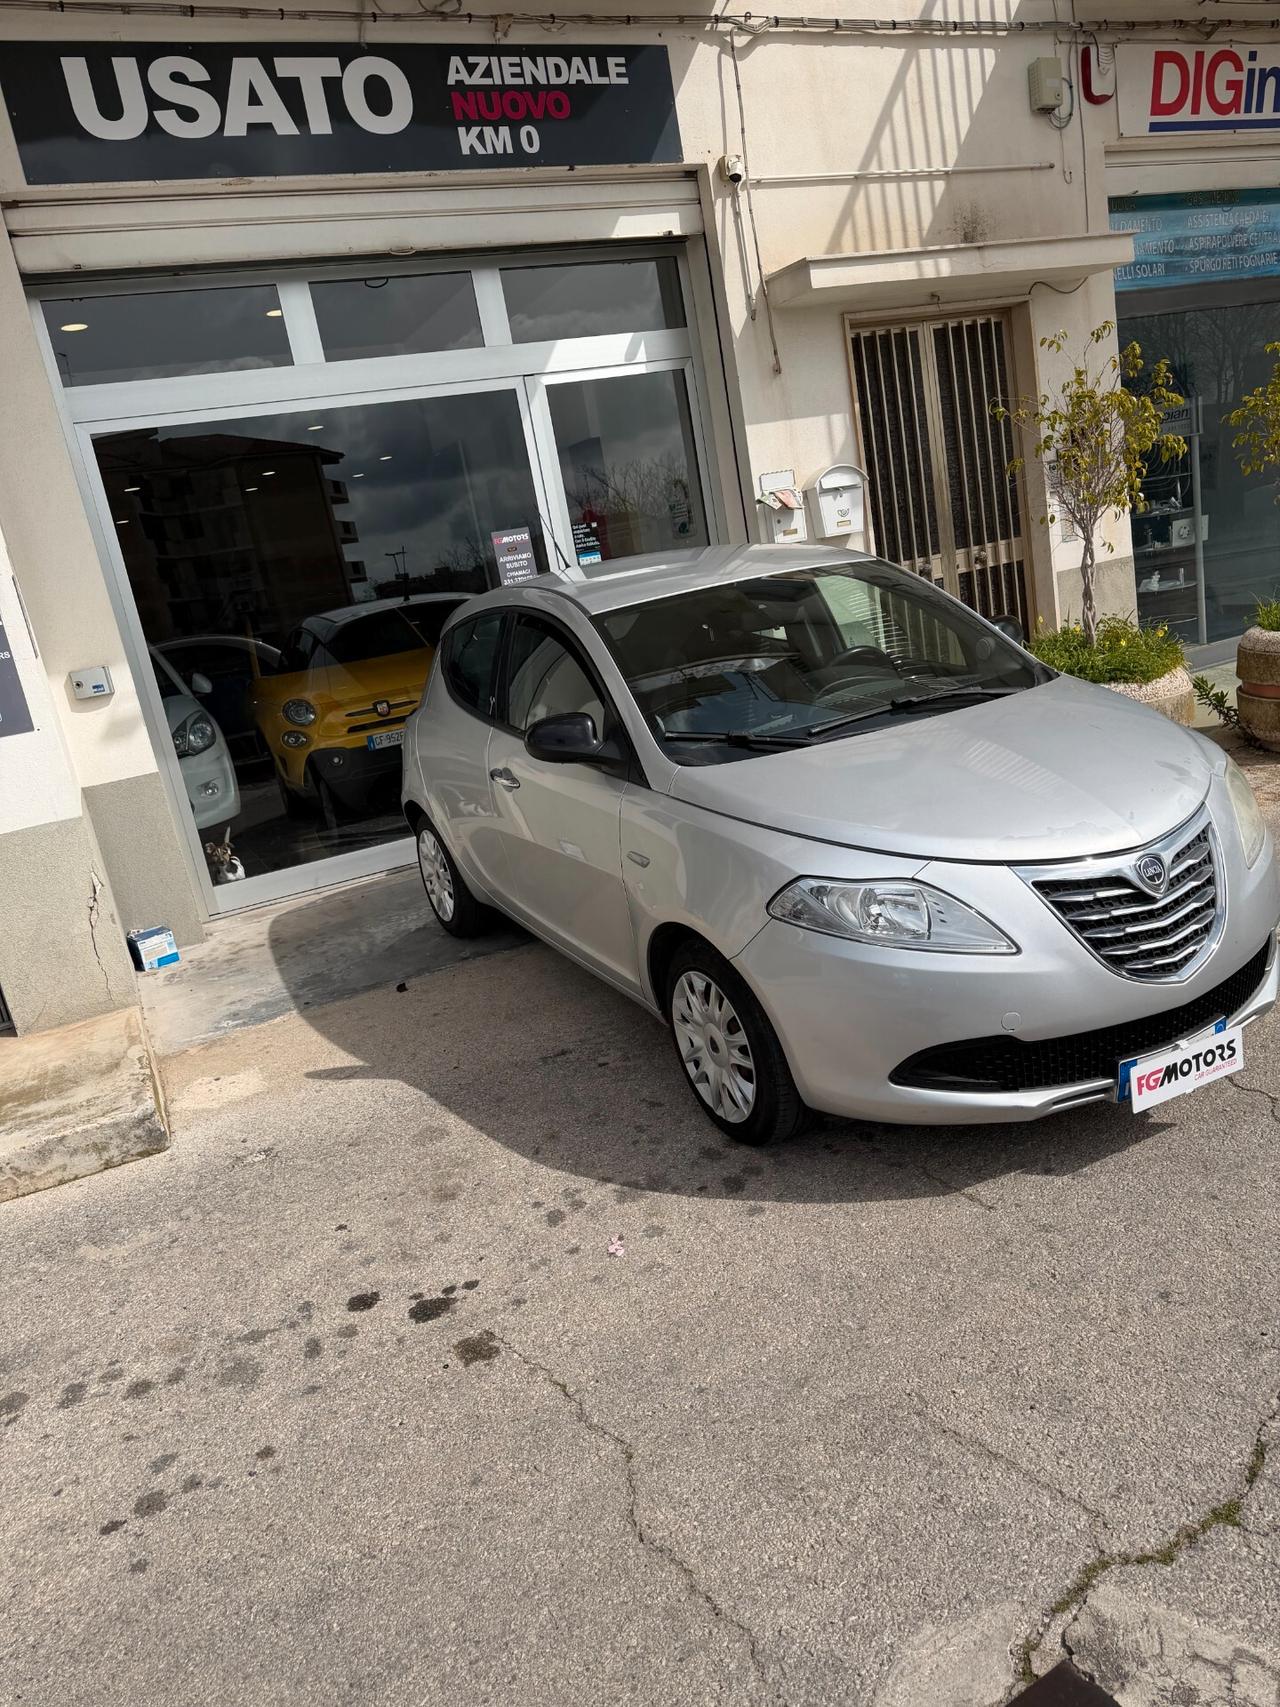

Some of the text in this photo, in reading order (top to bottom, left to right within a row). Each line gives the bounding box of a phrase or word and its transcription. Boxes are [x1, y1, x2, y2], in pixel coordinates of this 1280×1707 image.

[447, 56, 629, 86] AZIENDALE
[61, 56, 413, 140] USATO
[451, 90, 571, 121] NUOVO
[457, 126, 541, 155] KM 0
[1136, 263, 1165, 279] SOLARI
[1190, 252, 1278, 273] SPURGO RETI FOGNARIE
[505, 560, 528, 570] SUBITO
[1143, 865, 1162, 877] LANCIA
[1194, 1058, 1237, 1081] CAR GUARANTEED
